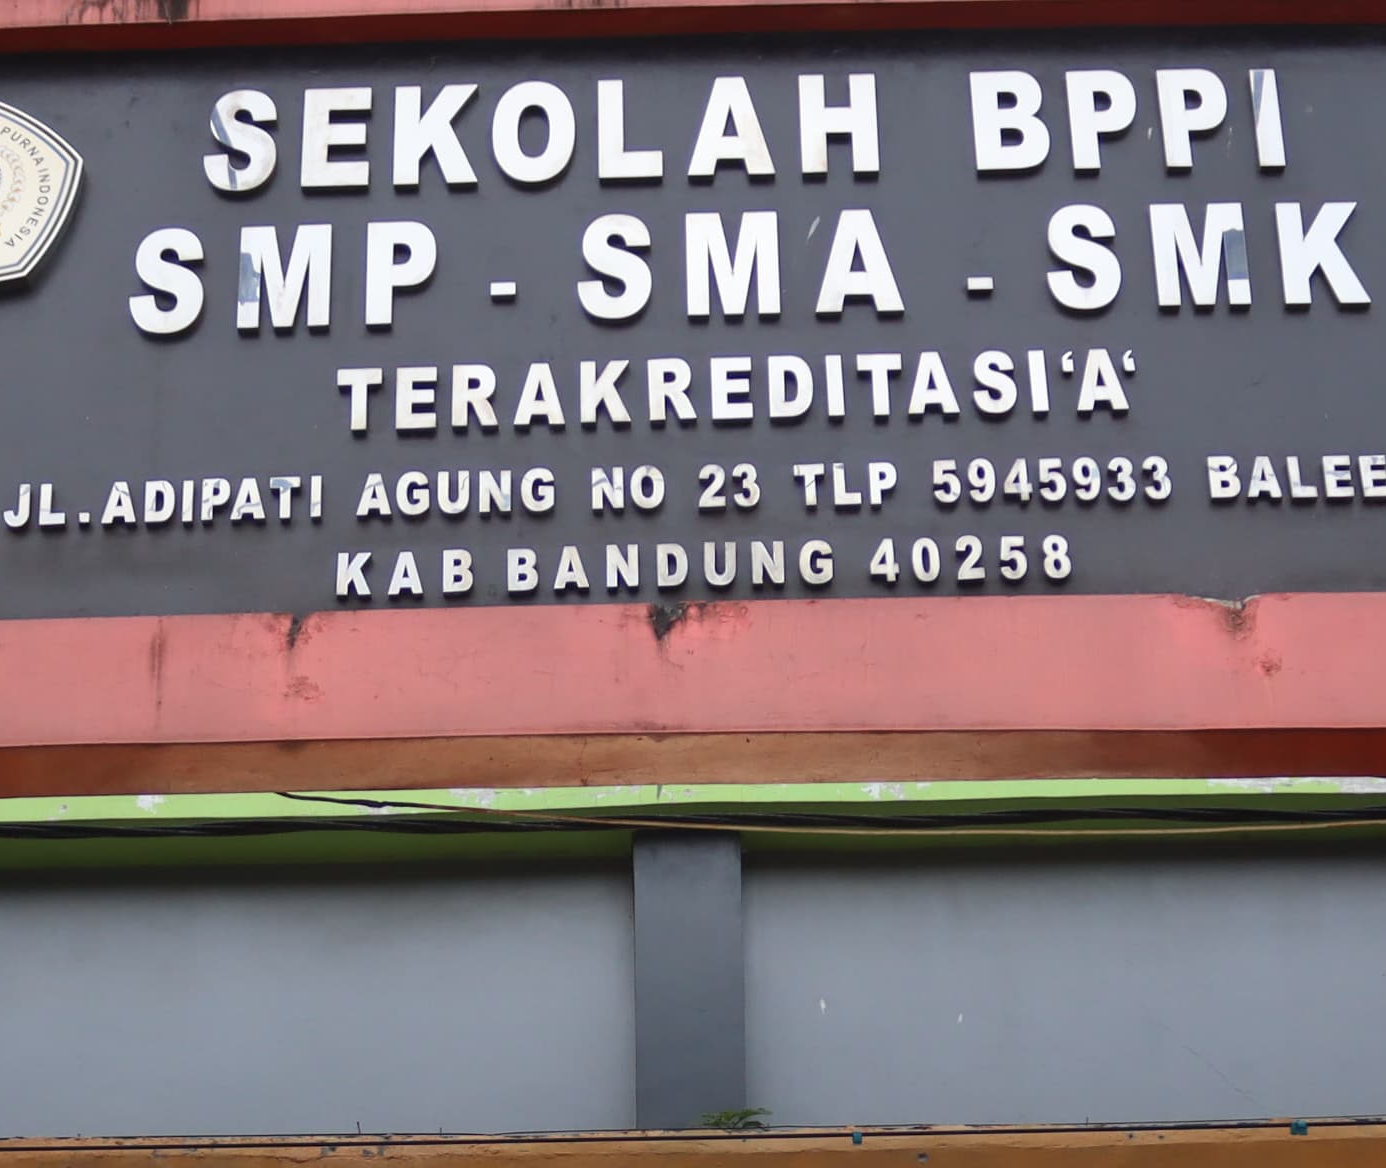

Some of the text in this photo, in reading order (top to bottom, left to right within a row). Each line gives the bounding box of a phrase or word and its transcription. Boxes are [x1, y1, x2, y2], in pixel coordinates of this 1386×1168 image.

[203, 68, 1286, 192] SEKOLAH BPPI
[5, 168, 50, 248] INDONESIA
[129, 221, 438, 335] SMP
[578, 209, 905, 321] SMA
[1045, 201, 1372, 311] SMK
[357, 467, 556, 517] AGUNG
[592, 465, 666, 513] NO
[698, 463, 761, 508] 23
[793, 462, 897, 507] TLP
[932, 455, 1173, 503] 5945933
[335, 535, 1072, 598] KAB BANDUNG 40258
